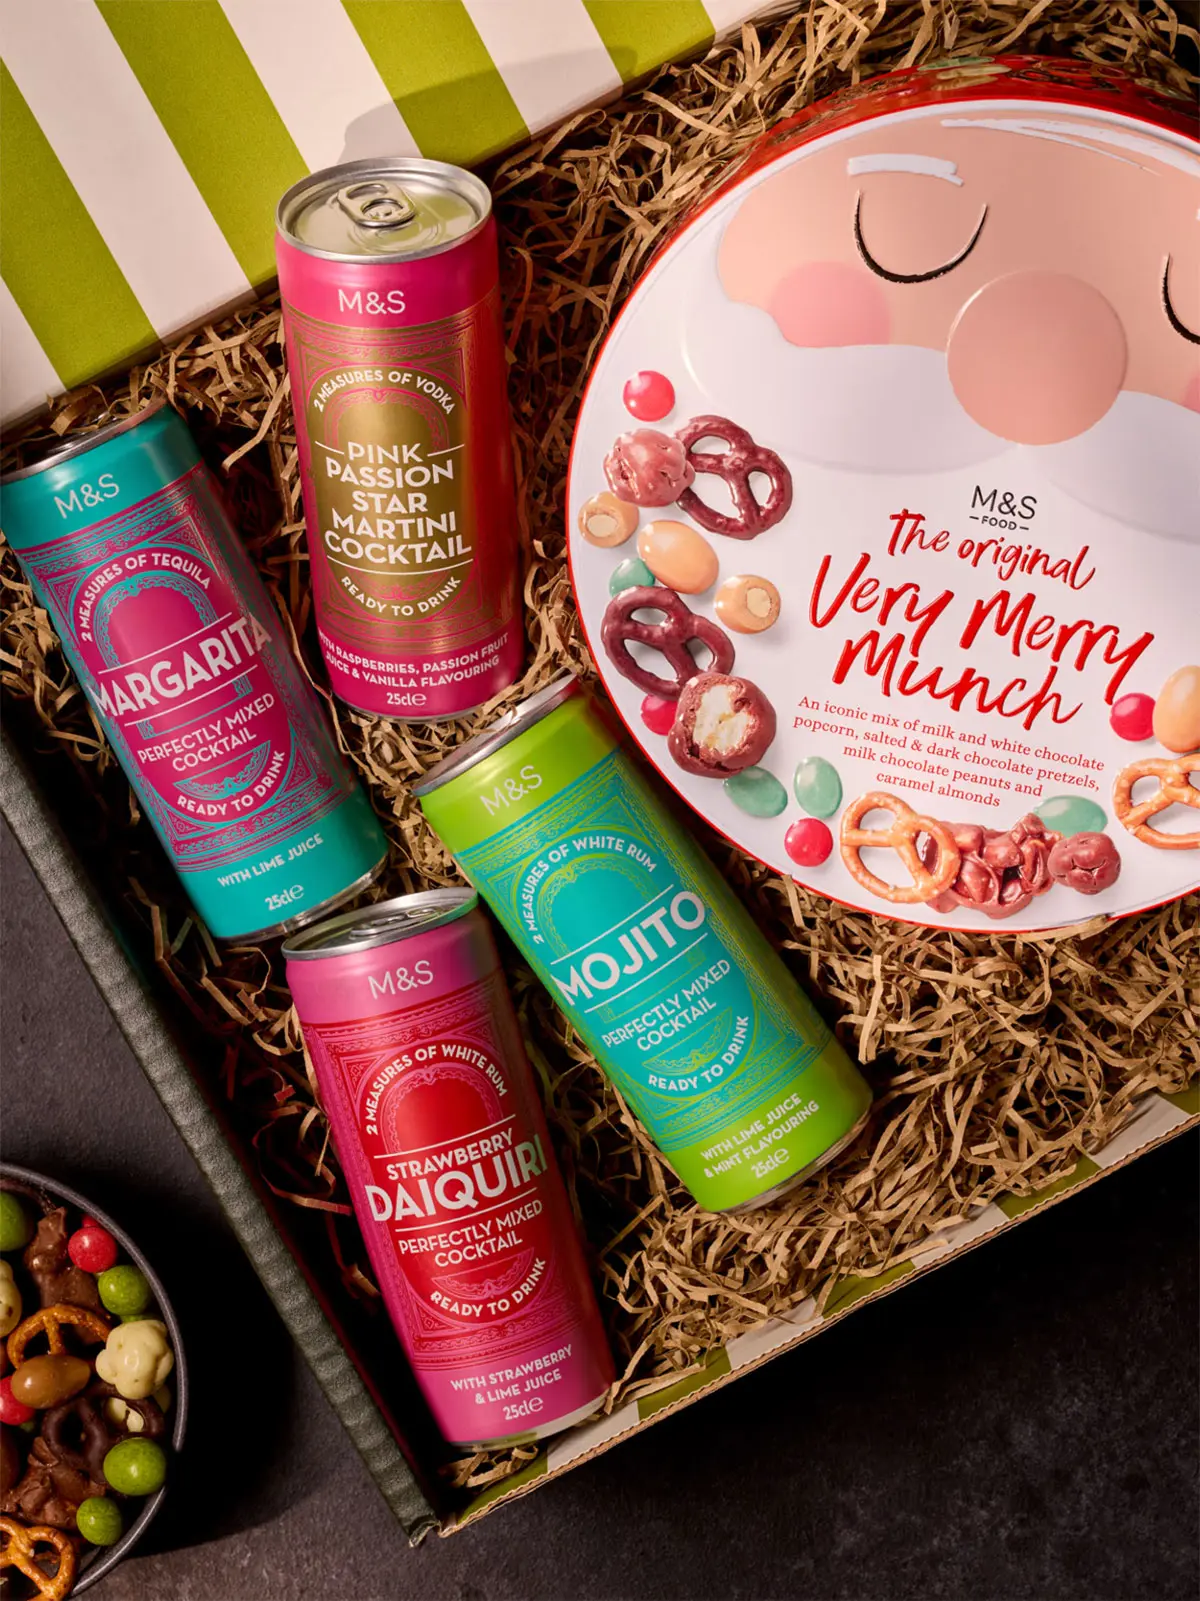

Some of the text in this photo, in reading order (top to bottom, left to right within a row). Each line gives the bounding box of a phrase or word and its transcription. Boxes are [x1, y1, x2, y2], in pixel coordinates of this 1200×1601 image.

[338, 289, 405, 314] M&S
[314, 369, 456, 414] 2 MEASURES OF VODKA
[326, 457, 454, 488] PASSION
[348, 442, 422, 464] PINK
[53, 473, 120, 519] M&S
[352, 491, 428, 514] STAR
[971, 485, 1037, 520] M&S
[324, 530, 472, 564] COCKTAIL
[332, 508, 456, 540] MARTINI
[888, 508, 1096, 590] The original
[981, 515, 1017, 531] FOOD
[79, 553, 211, 642] 2 MEASURES OF TEQUILA
[341, 576, 461, 616] READY TO DRINK
[336, 646, 419, 674] RASPBERRIES,
[423, 651, 478, 672] PASSION
[481, 633, 508, 657] FRUIT
[808, 553, 1155, 705] Very Merry
[89, 612, 272, 717] MARGARITA
[326, 651, 499, 687] JUICE & VANILLA FLAVOURING
[832, 630, 1083, 731] Munch
[137, 693, 275, 764] PERFECTLY MIXED
[172, 727, 257, 772] COCKTAIL
[793, 715, 1100, 792] popcorn, salted & dark chocolate pretzels,
[798, 695, 1105, 771] An iconic mix of milk and white chocolate
[177, 750, 286, 816] READY TO DRINK
[480, 765, 543, 816] M&S
[842, 745, 1043, 797] milk chocolate peanuts and
[876, 770, 1000, 807] caramel almonds
[217, 833, 324, 887] WITH LIME JUICE
[522, 836, 656, 944] 2 MEASURES OF WHITE RUM
[550, 890, 705, 1006] MOJITO
[367, 960, 434, 999] M&S
[601, 959, 731, 1048] PERFECTLY MIXED
[636, 996, 717, 1052] COCKTAIL
[648, 1015, 750, 1091] READY TO DRINK
[366, 1044, 507, 1136] 2 MEASURES OF WHITE RUM
[700, 1093, 802, 1161] WITH LIME JUICE
[704, 1100, 820, 1178] & MINT FLAVOURING
[365, 1134, 547, 1222] DAIQUIRI
[386, 1128, 513, 1181] STRAWBERRY
[398, 1199, 543, 1254] PERFECTLY MIXED
[435, 1230, 523, 1267] COCKTAIL
[430, 1258, 547, 1317] READY TO DRINK
[451, 1344, 572, 1391] WITH STRAWBERRY
[475, 1369, 562, 1404] & LIME JUICE
